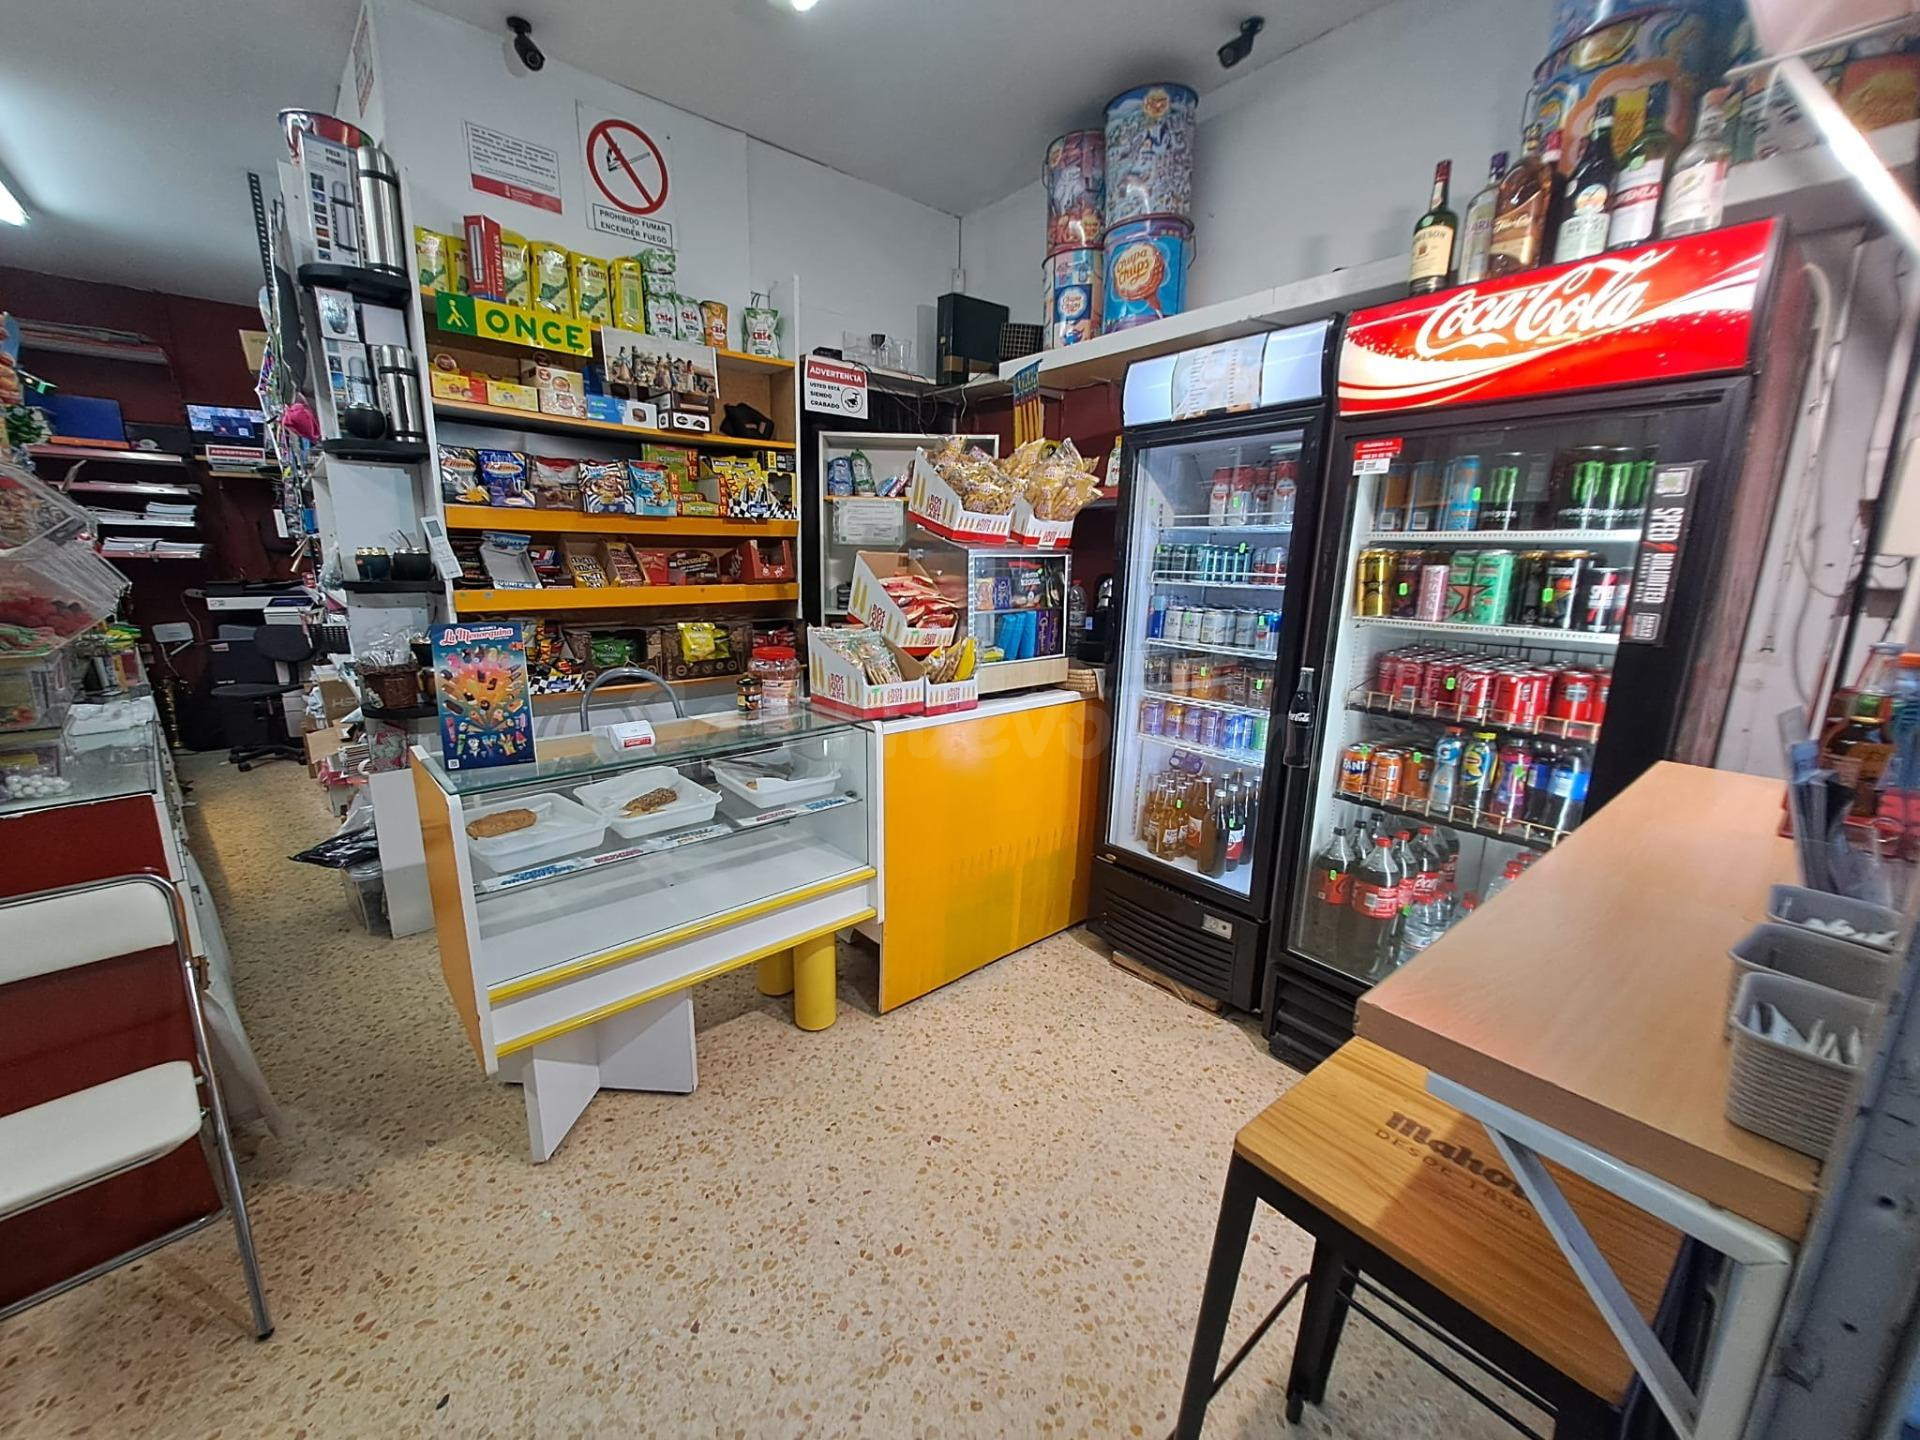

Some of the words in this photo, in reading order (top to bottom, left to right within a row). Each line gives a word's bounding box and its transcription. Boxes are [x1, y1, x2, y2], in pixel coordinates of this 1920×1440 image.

[599, 209, 639, 226] PROHIBIDO
[641, 220, 667, 233] FUMAR
[600, 221, 641, 237] ENCENDER
[643, 230, 668, 244] FUEGO
[1414, 247, 1675, 358] Coca-Cola
[485, 309, 585, 350] ONCE
[810, 366, 862, 383] ADVERTENCIA
[810, 391, 832, 399] SIENDO
[810, 400, 840, 409] GRABADO
[1647, 507, 1685, 541] SPEED
[1643, 553, 1675, 604] UNLIMITED
[872, 604, 886, 617] ROS
[440, 629, 457, 646] La
[455, 627, 514, 645] Menorquina
[830, 673, 844, 683] ROS
[830, 681, 844, 692] QUI
[831, 690, 845, 701] ART
